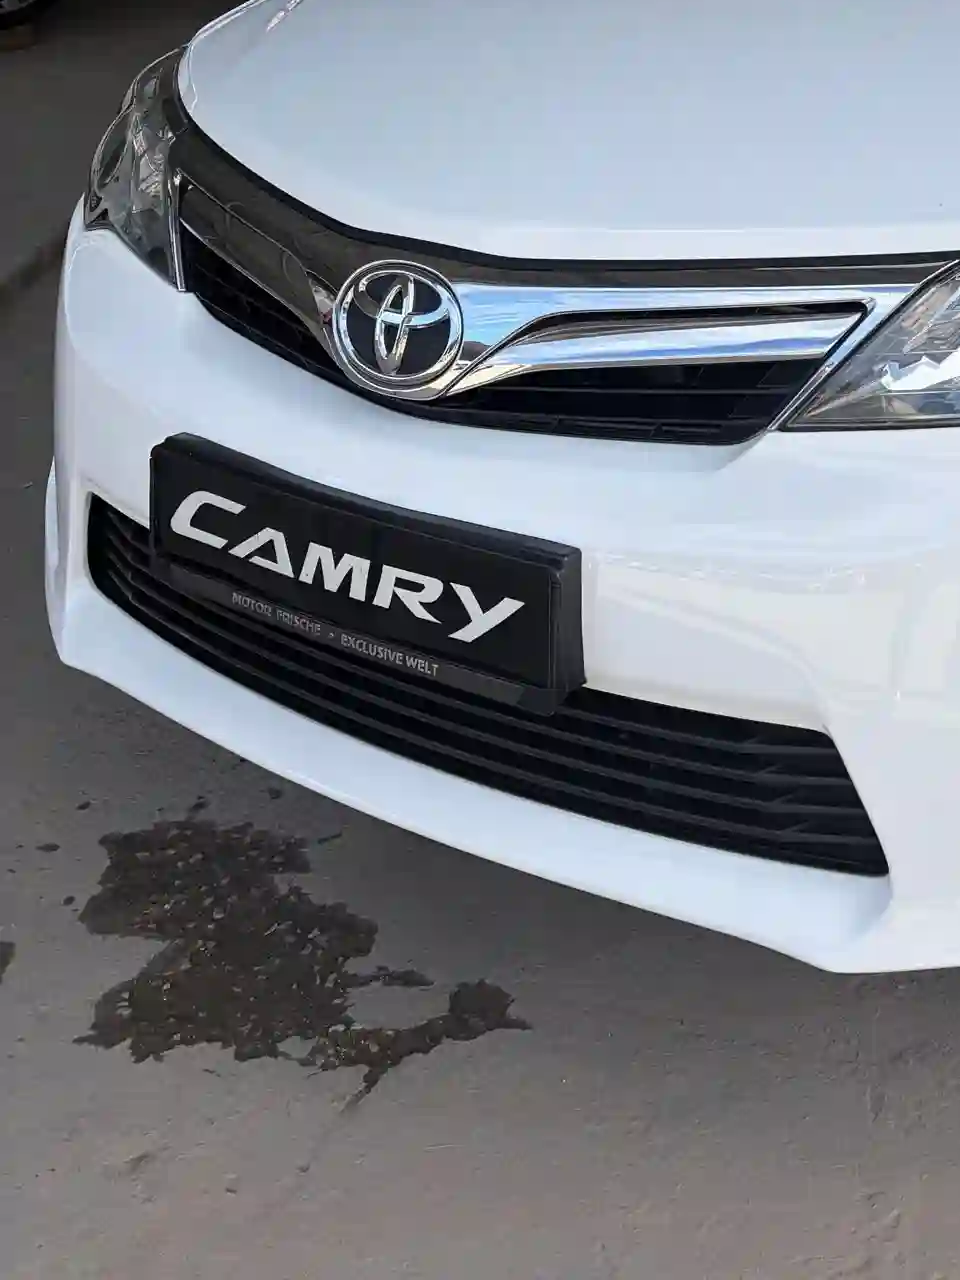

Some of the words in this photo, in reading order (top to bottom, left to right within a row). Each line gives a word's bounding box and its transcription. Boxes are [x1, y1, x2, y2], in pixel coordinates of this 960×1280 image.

[170, 489, 526, 643] CAMRY
[231, 591, 272, 617] MOTOR
[340, 632, 404, 666] EXCLUSIVE
[404, 654, 440, 678] WELT
